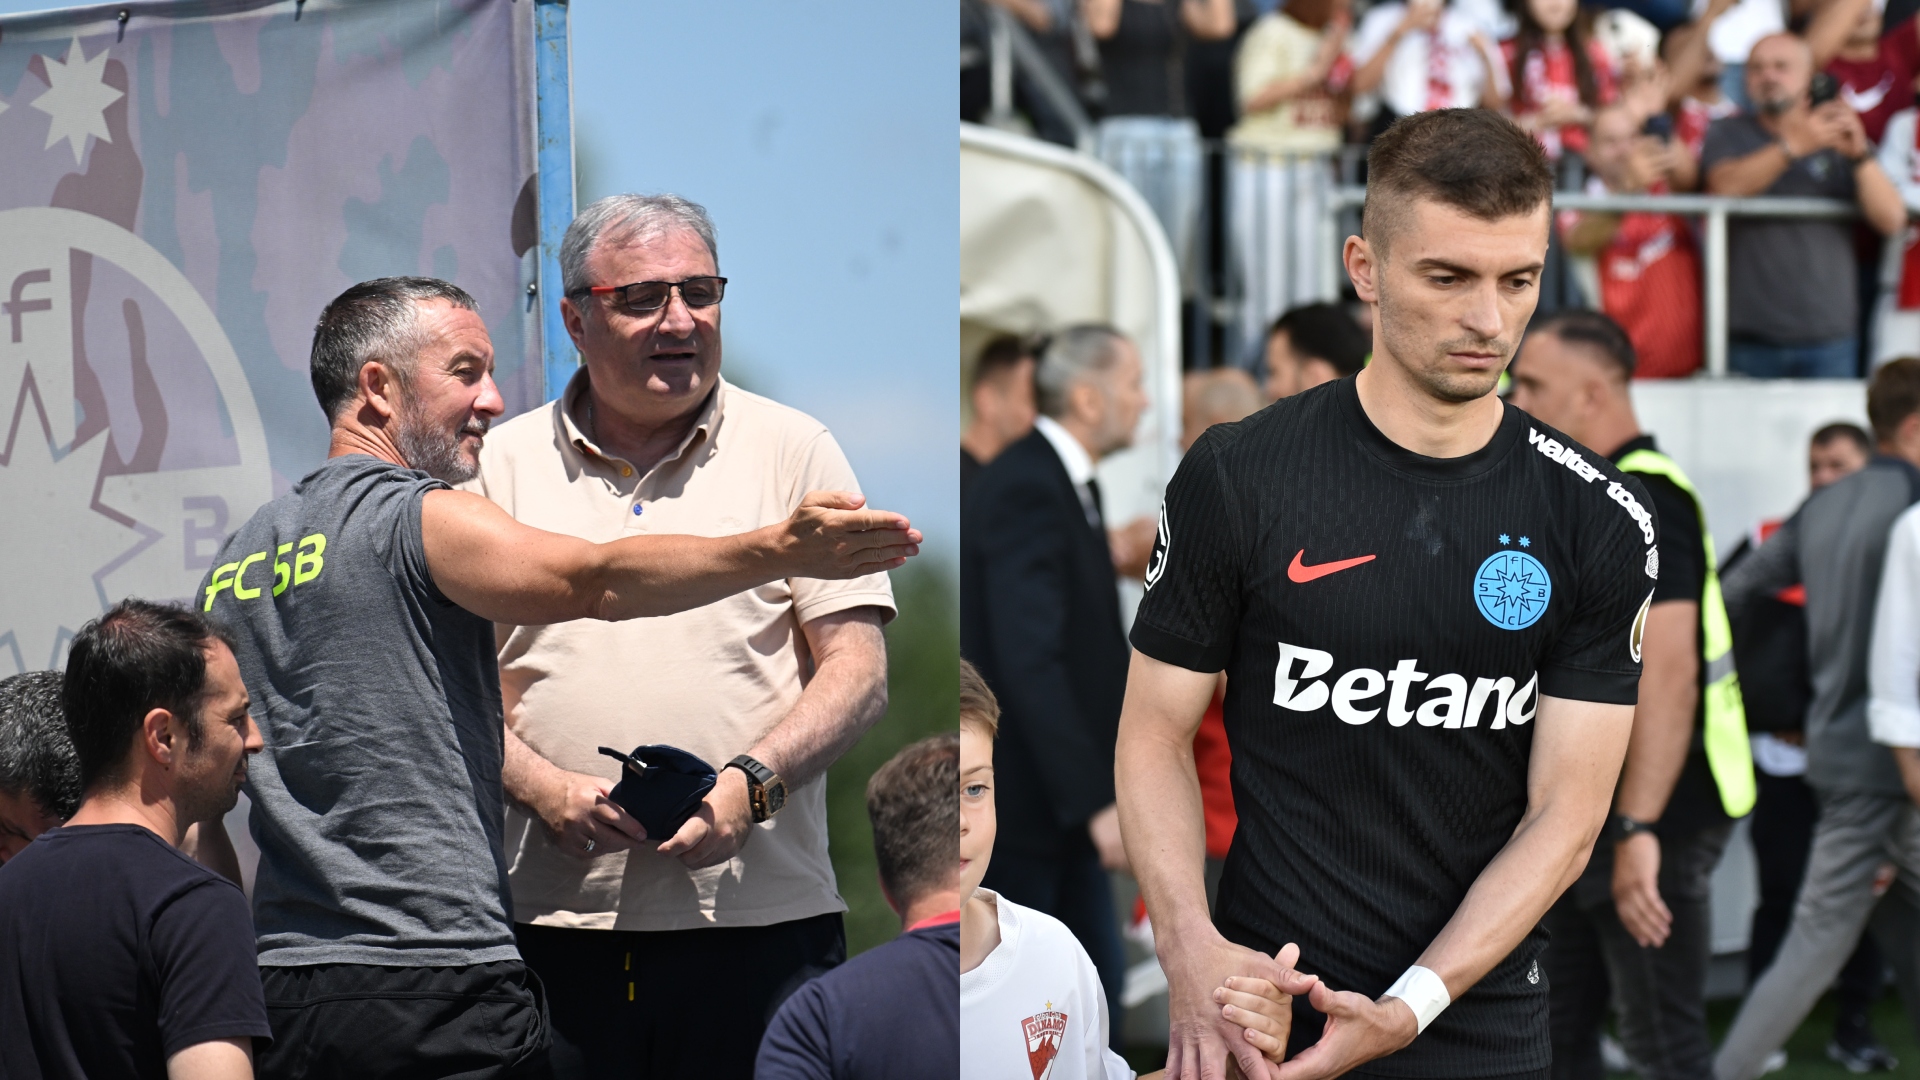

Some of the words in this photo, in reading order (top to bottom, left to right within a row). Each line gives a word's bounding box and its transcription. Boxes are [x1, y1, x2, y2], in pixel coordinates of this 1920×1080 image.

[2, 269, 52, 343] F
[1528, 426, 1607, 483] walter
[1606, 481, 1655, 545] tosto
[183, 495, 230, 570] B
[1507, 615, 1516, 625] C
[1537, 588, 1546, 598] B
[1272, 641, 1539, 730] Betano
[1027, 1018, 1064, 1036] DINAMO
